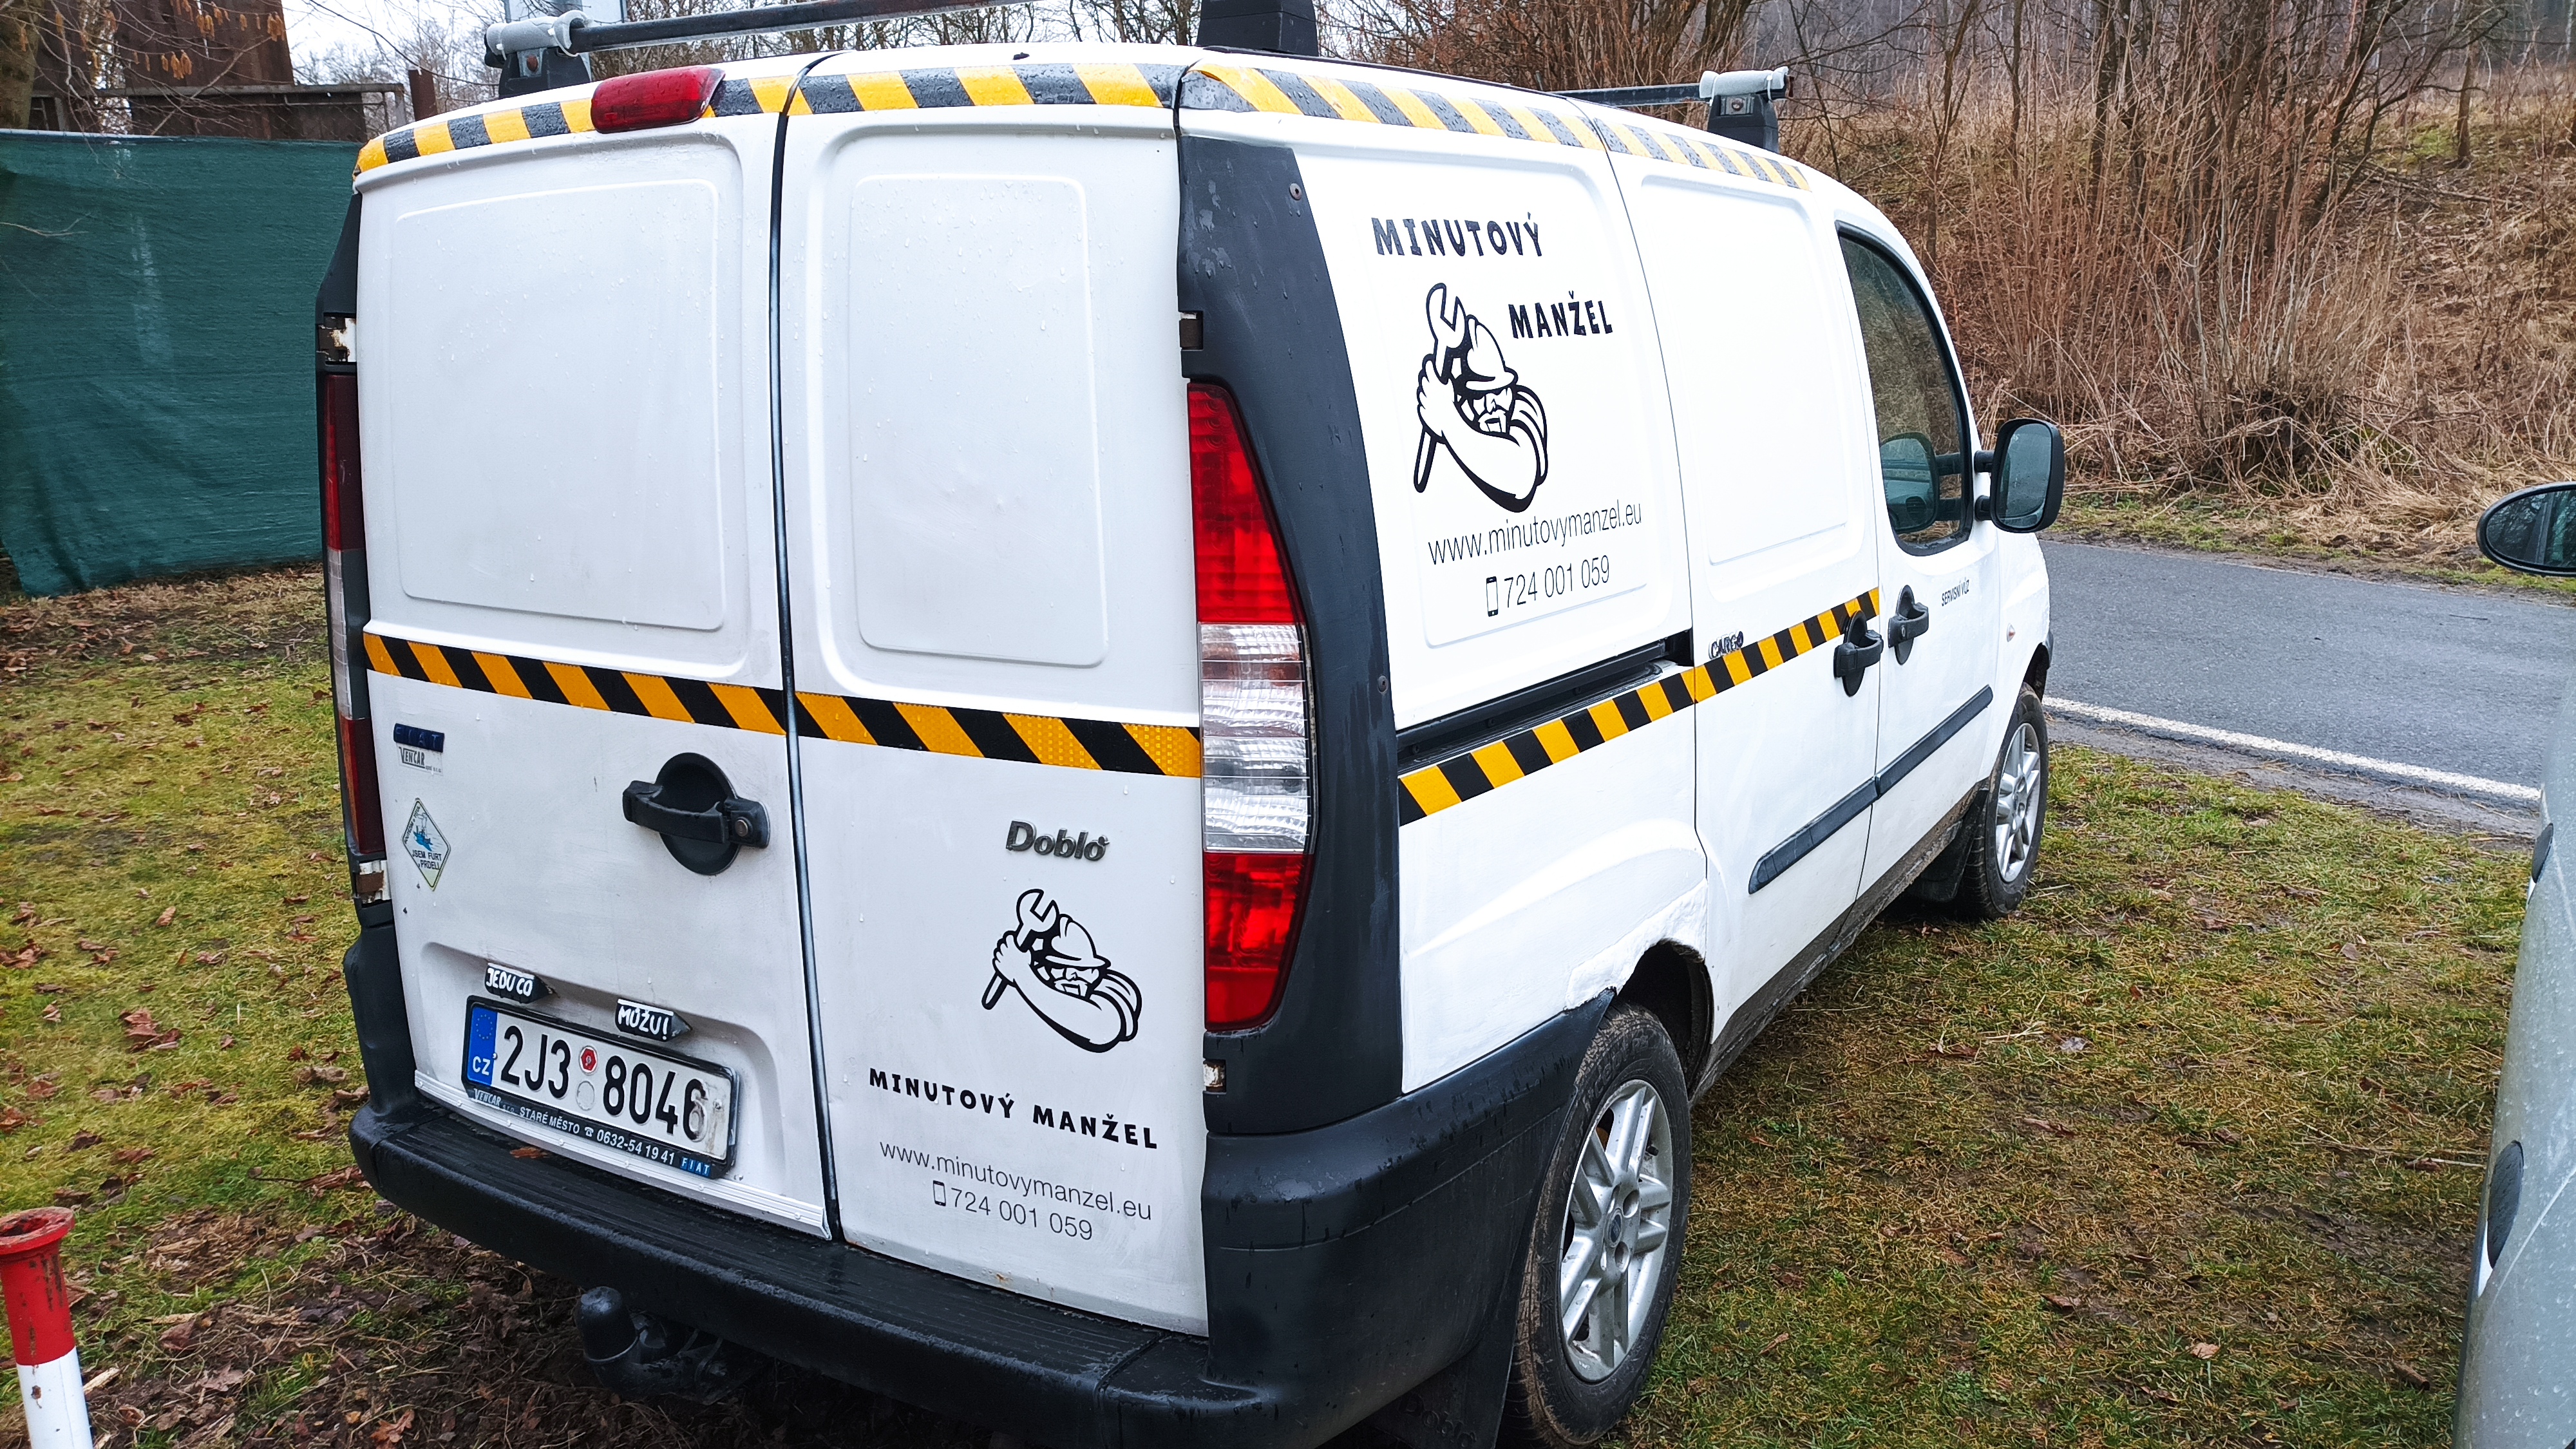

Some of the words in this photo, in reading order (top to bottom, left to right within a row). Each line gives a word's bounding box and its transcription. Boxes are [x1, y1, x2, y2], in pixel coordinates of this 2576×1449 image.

[1371, 213, 1542, 257] MINUTOVÝ
[1508, 290, 1613, 339] MANŽEL
[1428, 499, 1642, 565] www.minutovymanzel.eu
[1504, 571, 1537, 609] 724
[1544, 562, 1574, 598] 001
[1581, 554, 1610, 591] 059
[396, 726, 440, 748] FIAT
[412, 849, 426, 858] JSEM
[428, 852, 442, 861] FURT
[486, 967, 516, 992] JEDU
[516, 975, 534, 997] CO
[472, 1056, 491, 1076] CZ
[500, 1025, 571, 1099] 2J3
[603, 1056, 708, 1142] 8046
[869, 1067, 1014, 1119] MINUTOVÝ
[1032, 1103, 1157, 1149] MANŽEL
[519, 1106, 548, 1124] STARÉ
[549, 1115, 580, 1134] MĚSTO
[596, 1129, 643, 1155] 0632-54
[645, 1144, 659, 1160] 19
[660, 1150, 675, 1165] 41
[681, 1157, 710, 1175] FIAT
[880, 1141, 1151, 1220] www.minutovymanzel.eu
[951, 1187, 991, 1216] 724
[999, 1199, 1038, 1228] 001
[1050, 1212, 1094, 1240] 059
